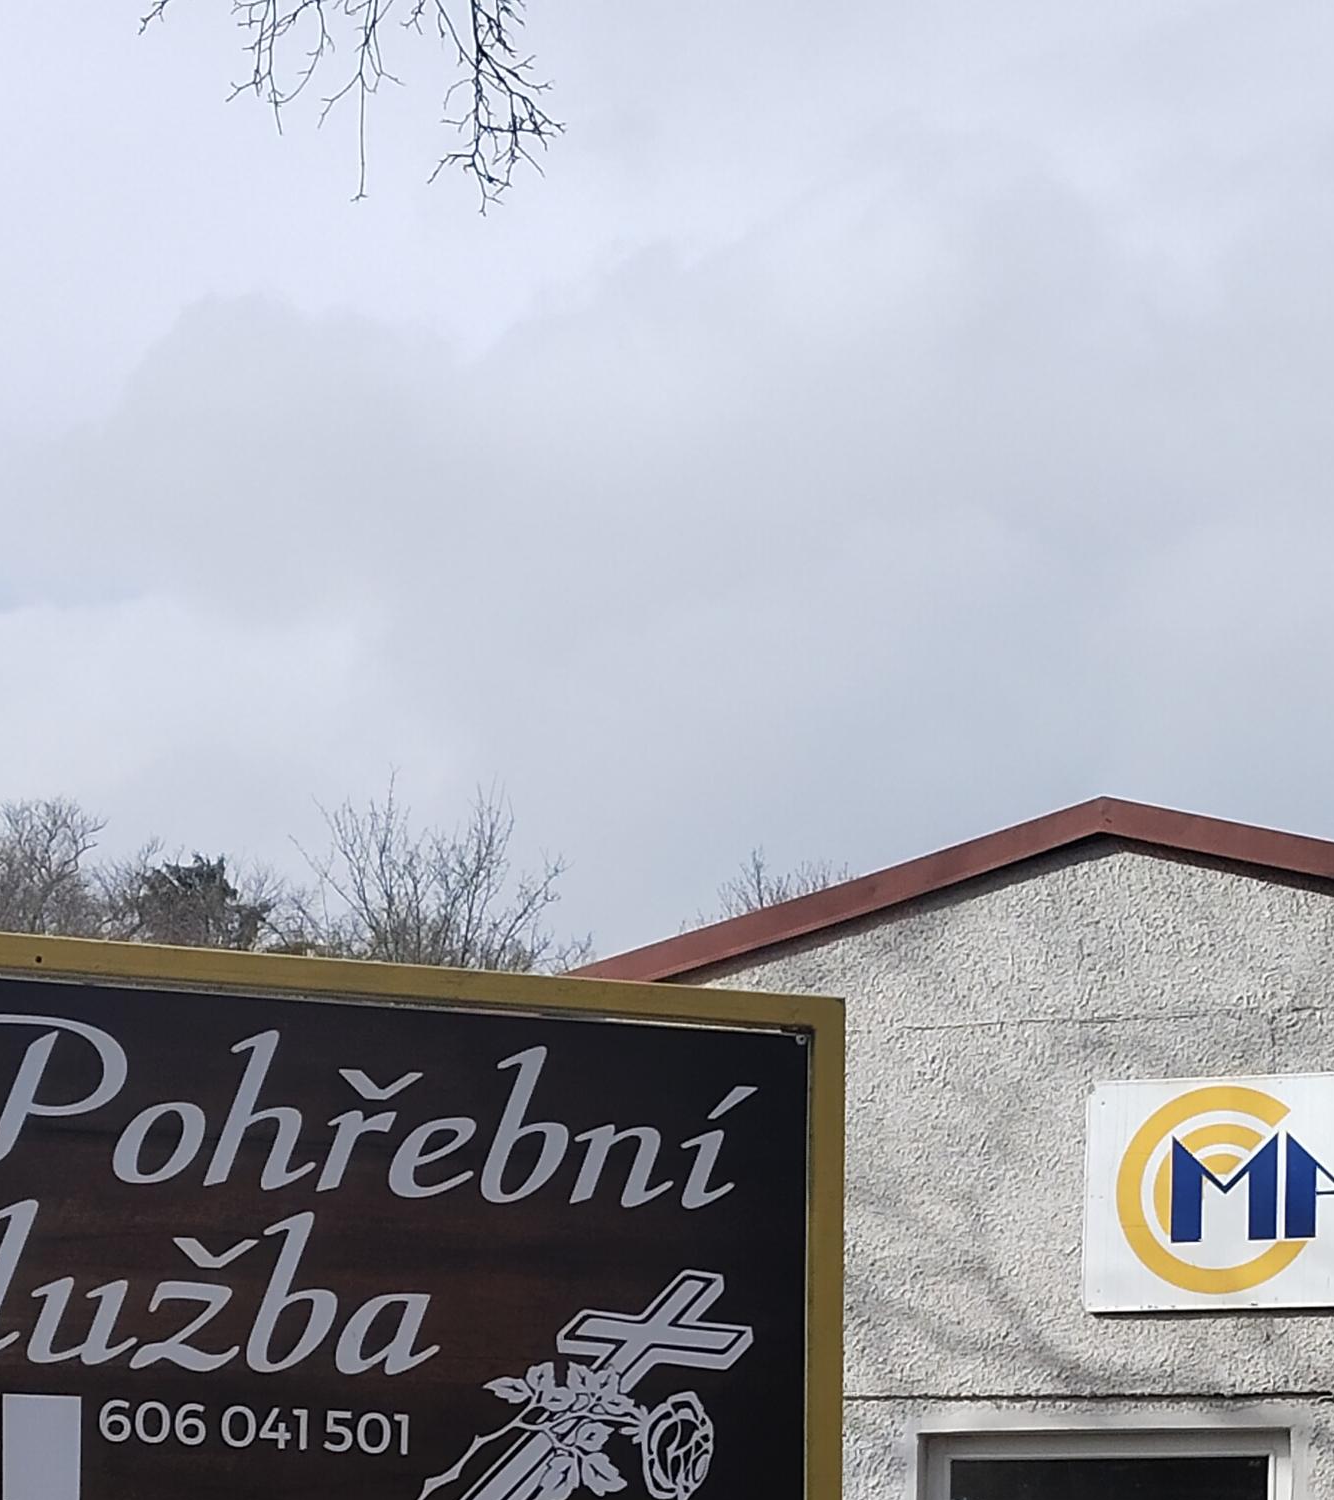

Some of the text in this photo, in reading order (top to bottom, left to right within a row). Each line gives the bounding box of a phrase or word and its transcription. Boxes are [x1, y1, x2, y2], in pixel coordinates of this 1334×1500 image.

[99, 1399, 410, 1456] 606 041 501
